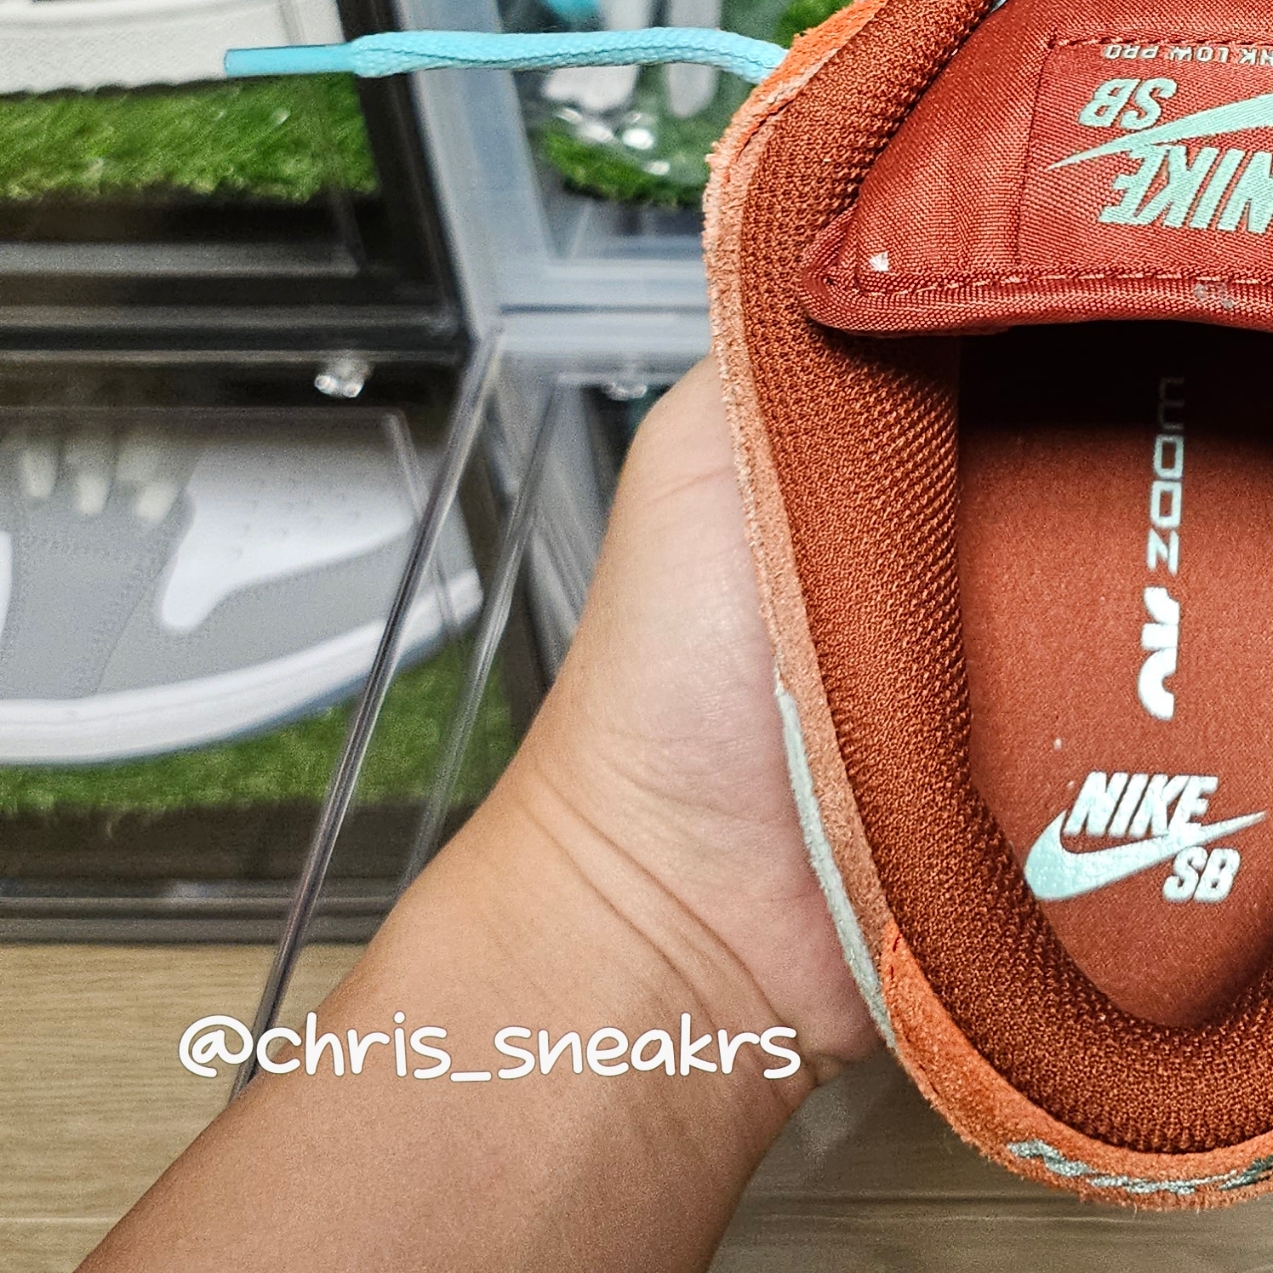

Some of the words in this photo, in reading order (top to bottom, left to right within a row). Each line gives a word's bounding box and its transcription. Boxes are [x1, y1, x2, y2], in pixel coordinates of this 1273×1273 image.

[1103, 43, 1159, 62] PRO
[1168, 45, 1230, 64] LOW
[1077, 77, 1178, 130] SB
[1062, 770, 1219, 837] NIKE
[1162, 845, 1241, 904] SB
